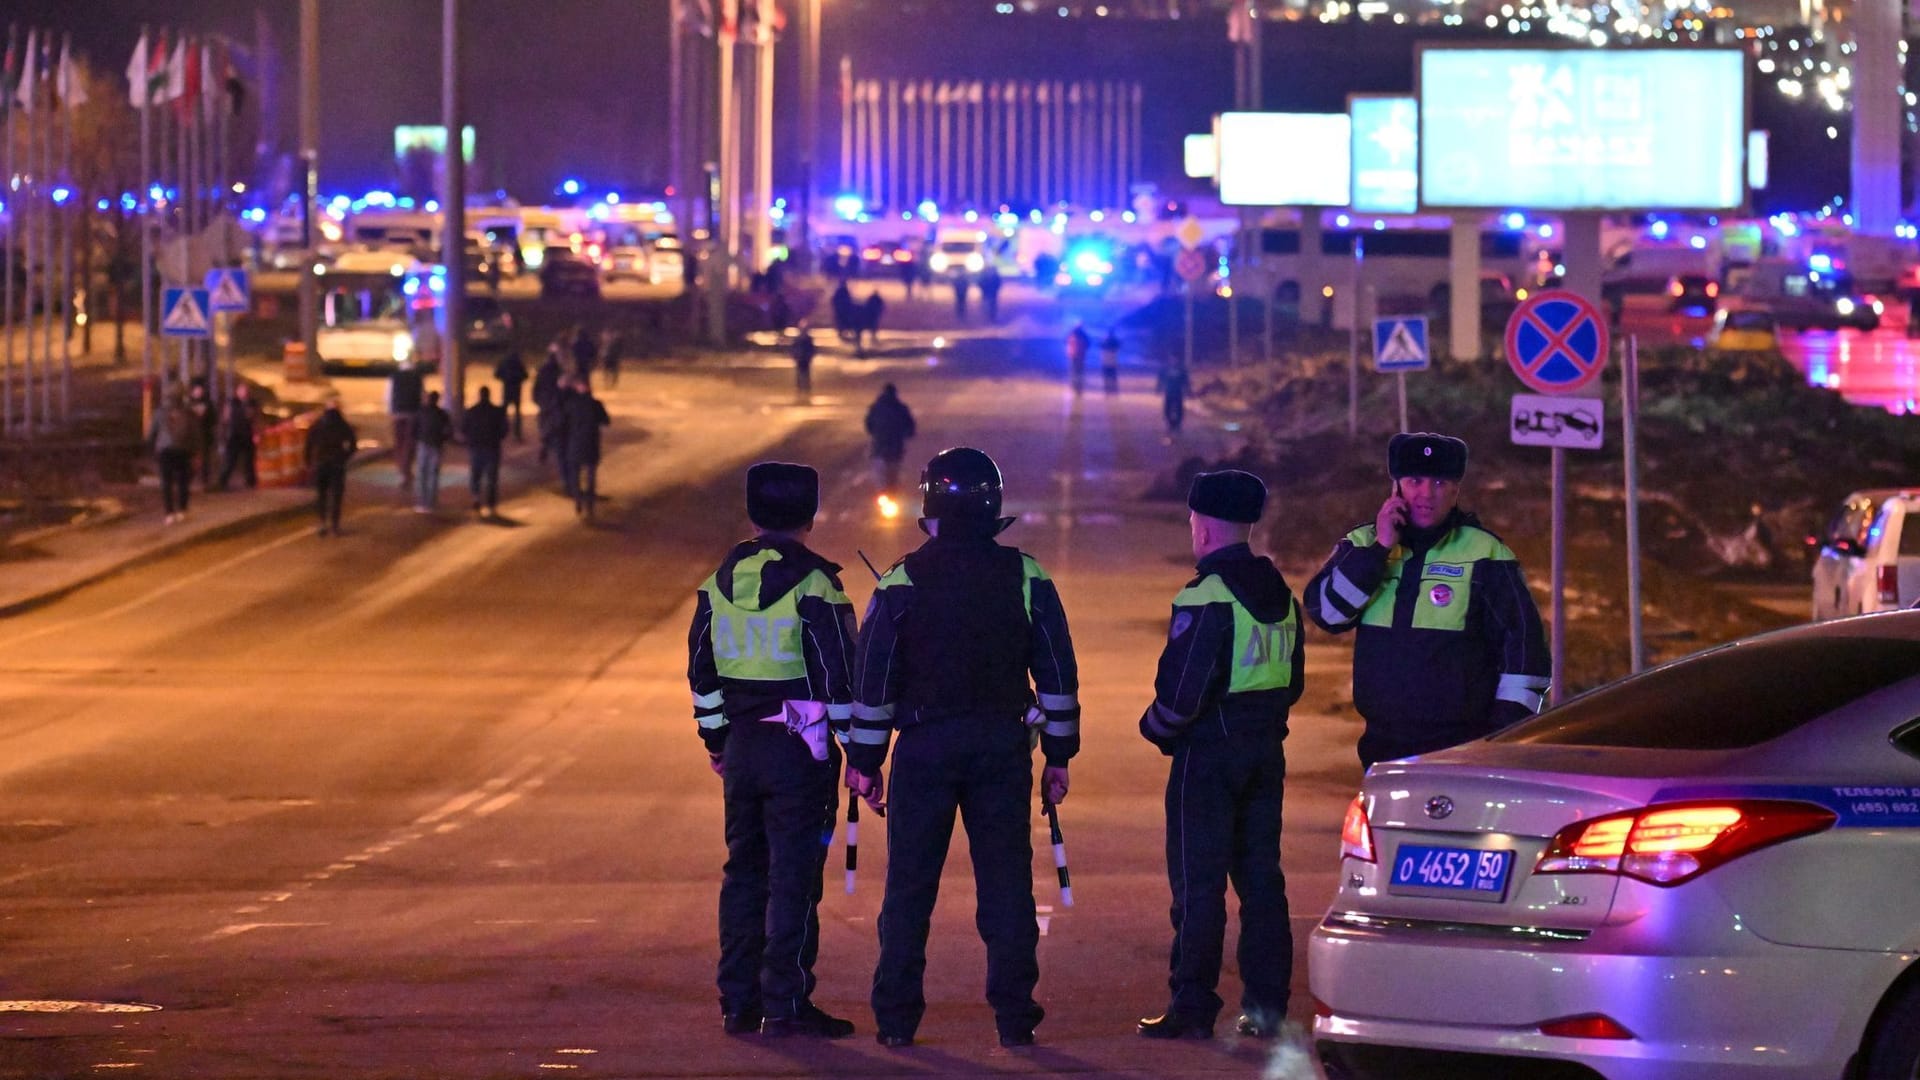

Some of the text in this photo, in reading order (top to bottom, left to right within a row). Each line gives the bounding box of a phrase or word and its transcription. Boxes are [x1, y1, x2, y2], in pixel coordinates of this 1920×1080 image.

[715, 615, 797, 661] ДПС
[1832, 786, 1908, 797] ТЕЛЕФОН
[1851, 802, 1889, 815] (495)
[1400, 850, 1503, 886] О 4652 50
